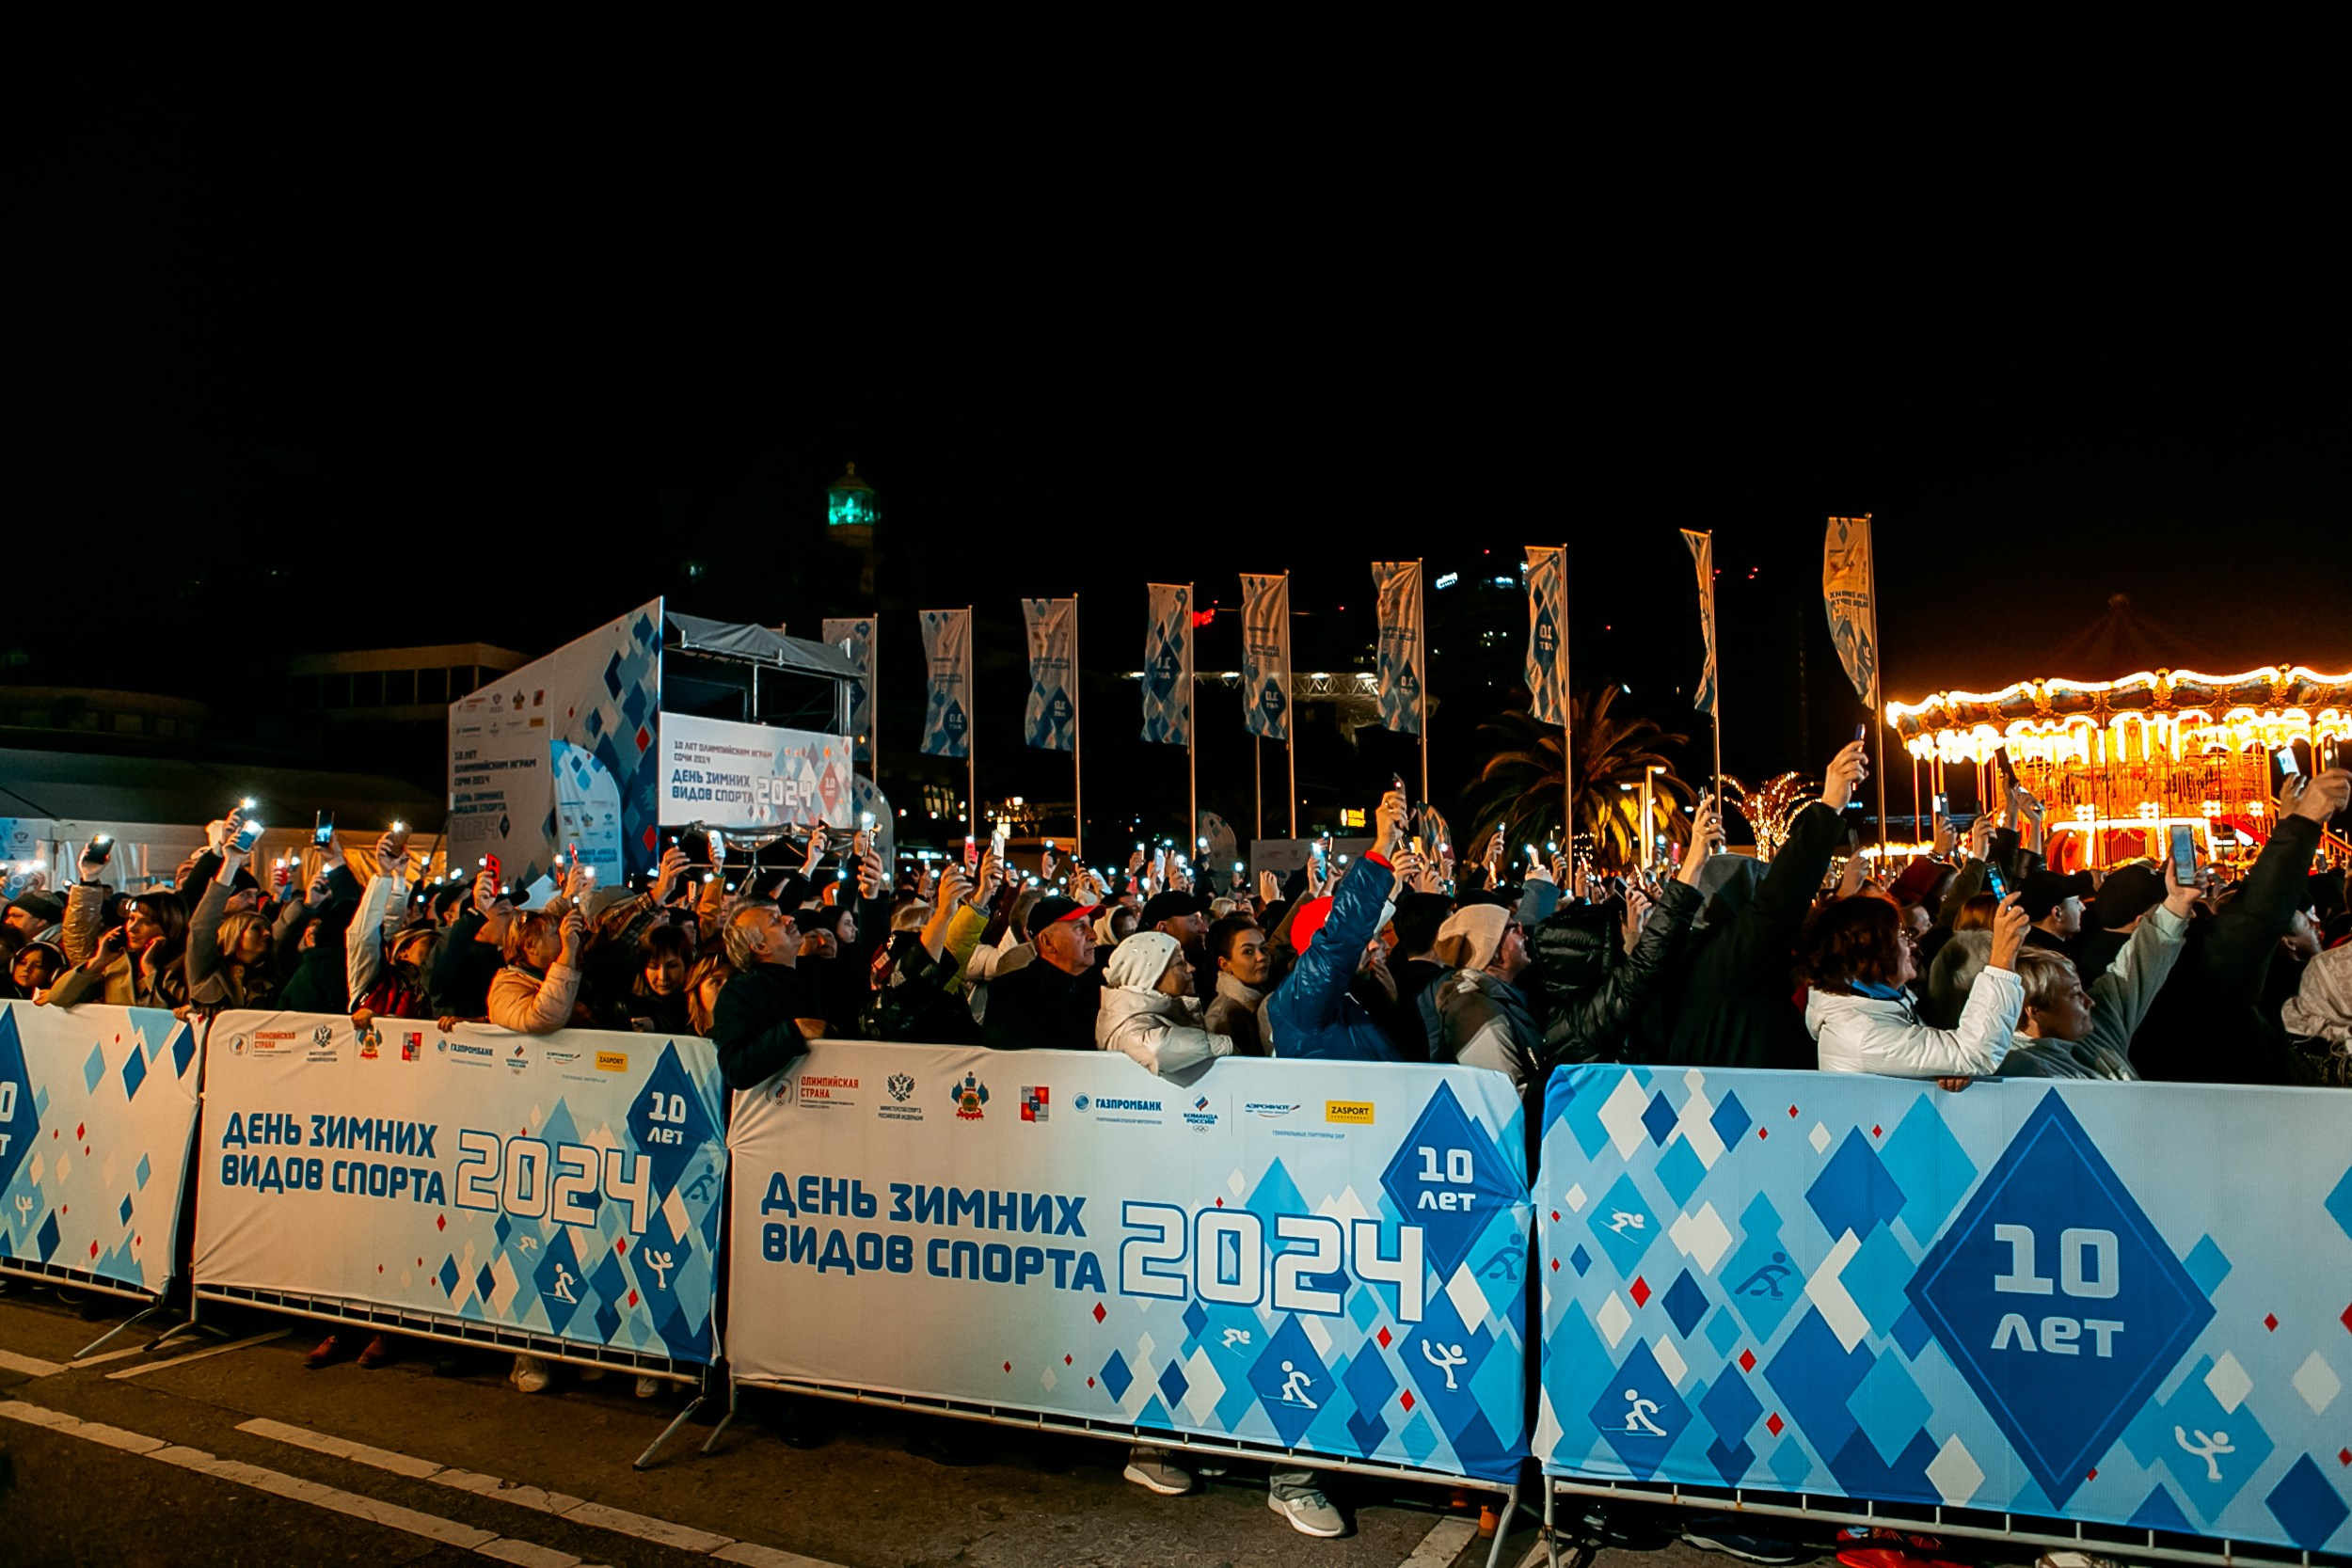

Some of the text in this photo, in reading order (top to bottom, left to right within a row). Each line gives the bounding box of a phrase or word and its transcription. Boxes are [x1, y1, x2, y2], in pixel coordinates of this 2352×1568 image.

[684, 742, 698, 751] ЛЕТ
[674, 752, 692, 762] СОЧИ
[672, 768, 751, 787] ДЕНЬ ЗИМНИХ
[824, 777, 836, 788] 10
[672, 785, 755, 804] ВИДОВ СПОРТА
[756, 776, 813, 808] 2024
[451, 1043, 494, 1057] ГАЗПРОМБАНК
[599, 1056, 624, 1065] ZASPORT
[801, 1075, 859, 1089] ОЛИМПИЙСКАЯ
[801, 1087, 830, 1099] СТРАНА
[648, 1091, 687, 1124] 10
[1095, 1098, 1162, 1112] ГАЗПРОМБАНК
[1245, 1102, 1290, 1111] АЭРОФЛОТ
[1331, 1106, 1370, 1116] ZASPORT
[222, 1112, 438, 1159] ДЕНЬ ЗИМНИХ
[1418, 1146, 1474, 1184] 10
[221, 1154, 447, 1206] ВИДОВ СПОРТА
[454, 1128, 653, 1237] 2024
[761, 1171, 1088, 1238] ДЕНЬ ЗИМНИХ
[762, 1222, 1107, 1293] ВИДОВ СПОРТА
[1120, 1199, 1427, 1324] 2024
[1994, 1223, 2120, 1299] 10
